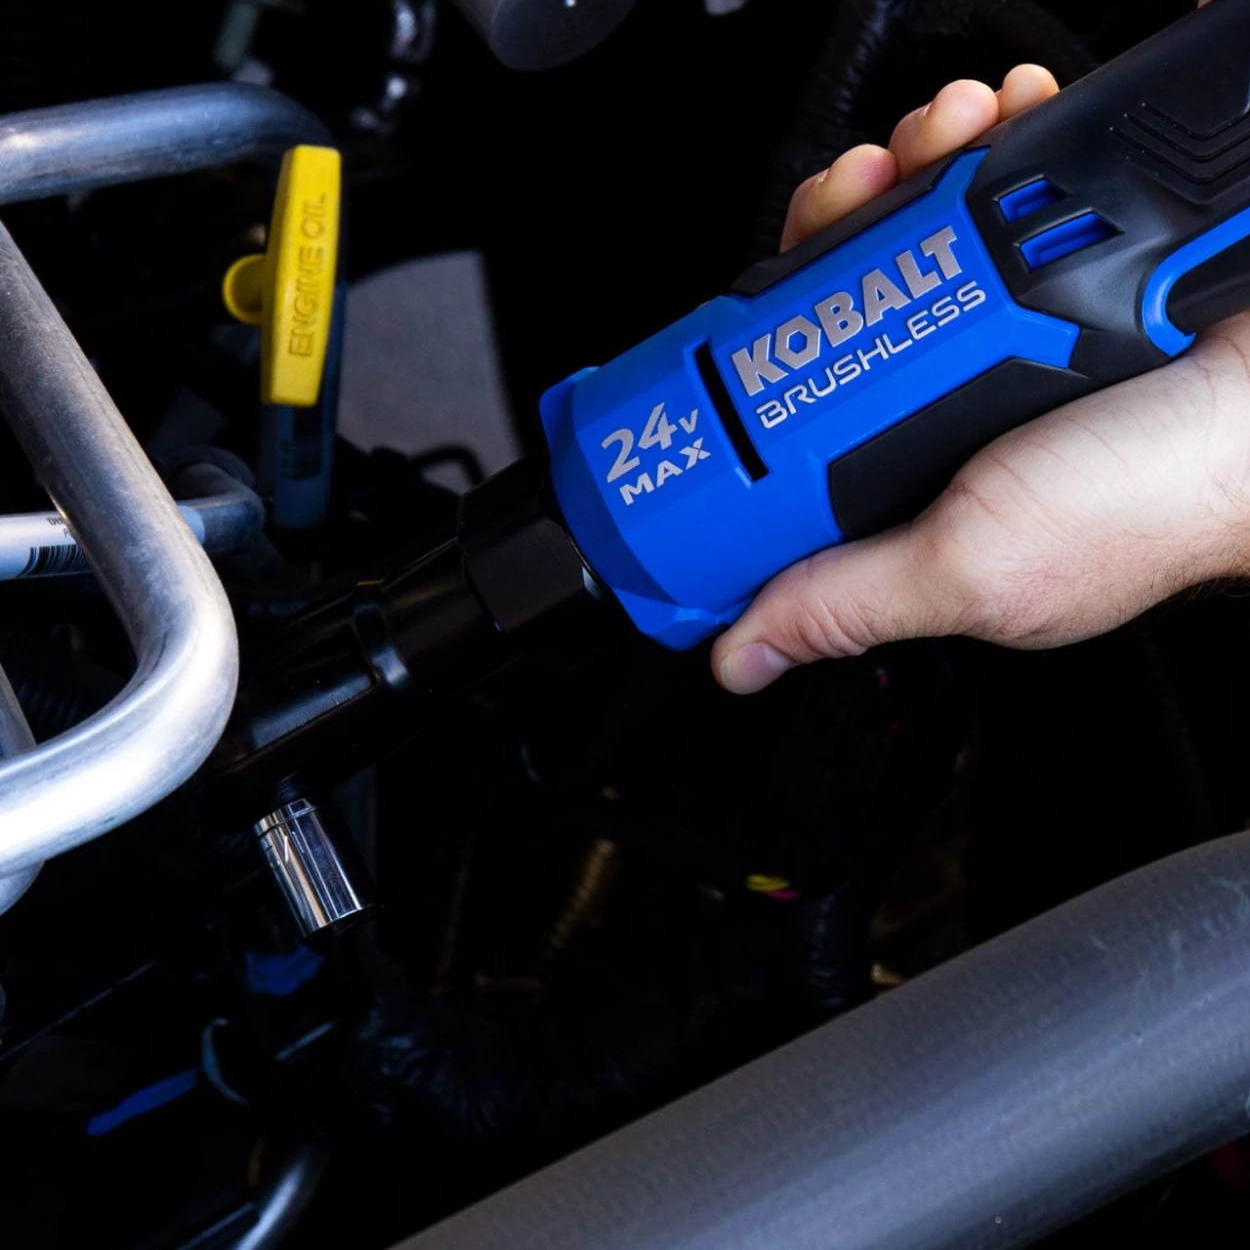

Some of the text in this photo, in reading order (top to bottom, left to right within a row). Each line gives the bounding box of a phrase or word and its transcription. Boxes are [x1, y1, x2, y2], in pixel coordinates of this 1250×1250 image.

[288, 192, 328, 357] ENGINE OIL
[731, 225, 963, 397] KOBALT
[756, 281, 987, 429] BRUSHLESS
[619, 438, 711, 505] MAX
